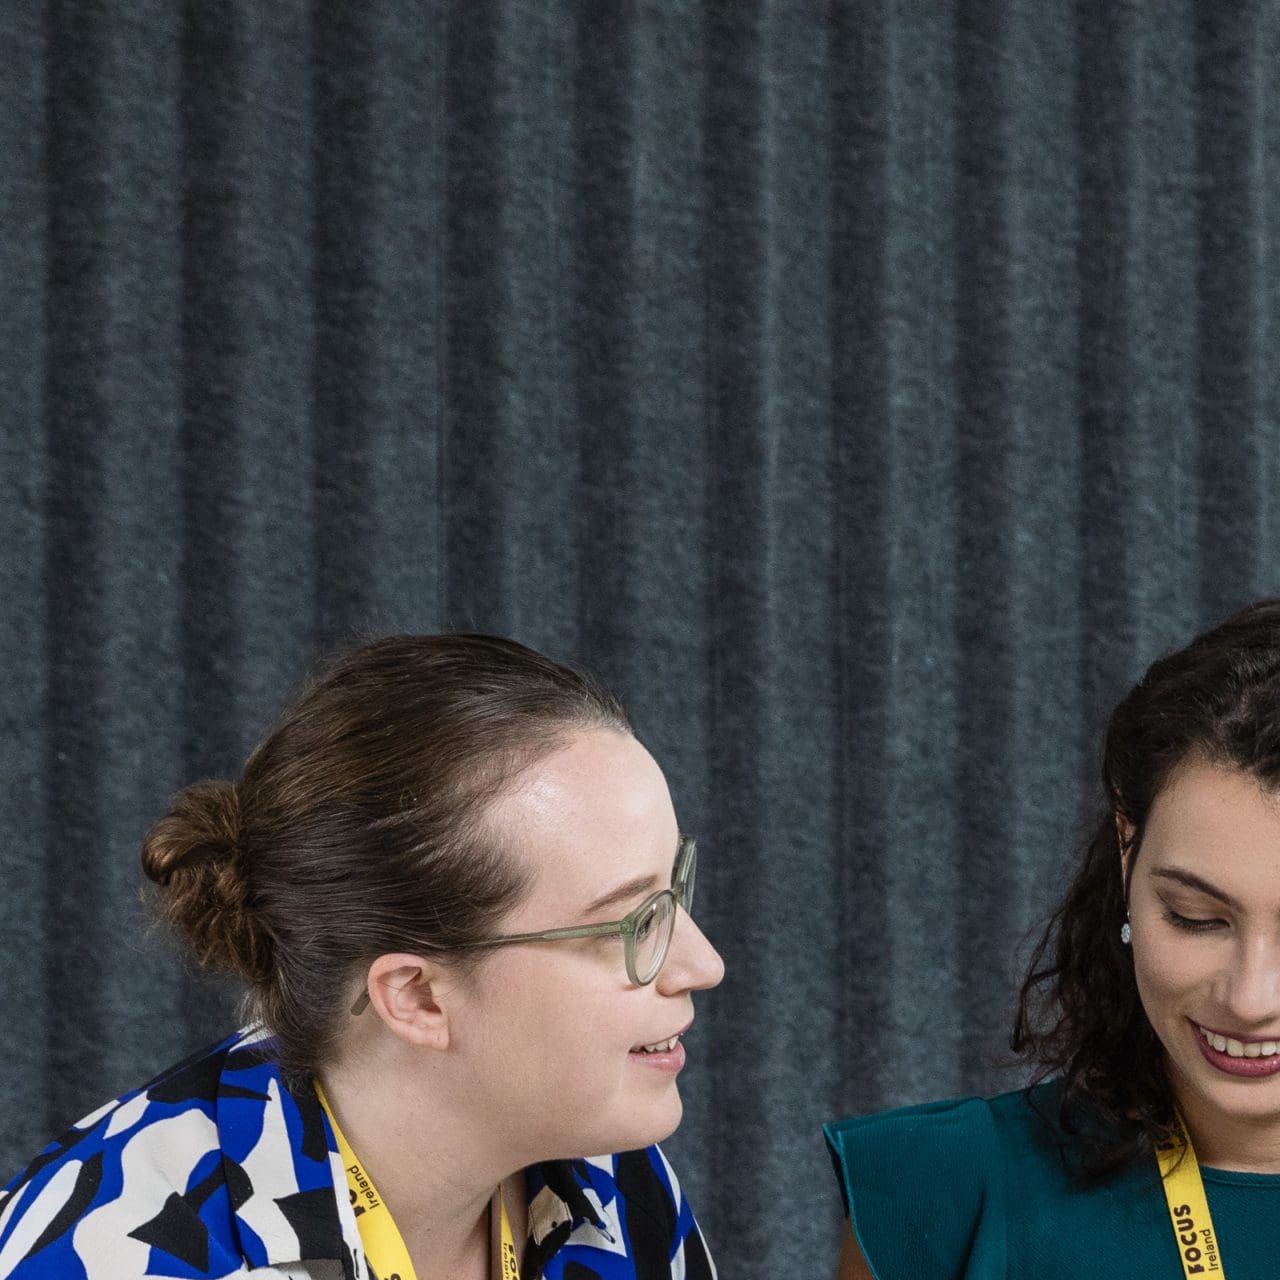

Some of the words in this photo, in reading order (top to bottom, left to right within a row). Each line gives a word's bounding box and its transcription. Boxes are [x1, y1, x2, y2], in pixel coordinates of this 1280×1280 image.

[347, 1165, 380, 1209] Ireland
[1174, 1203, 1205, 1275] FOCUS
[1199, 1228, 1219, 1272] Ireland
